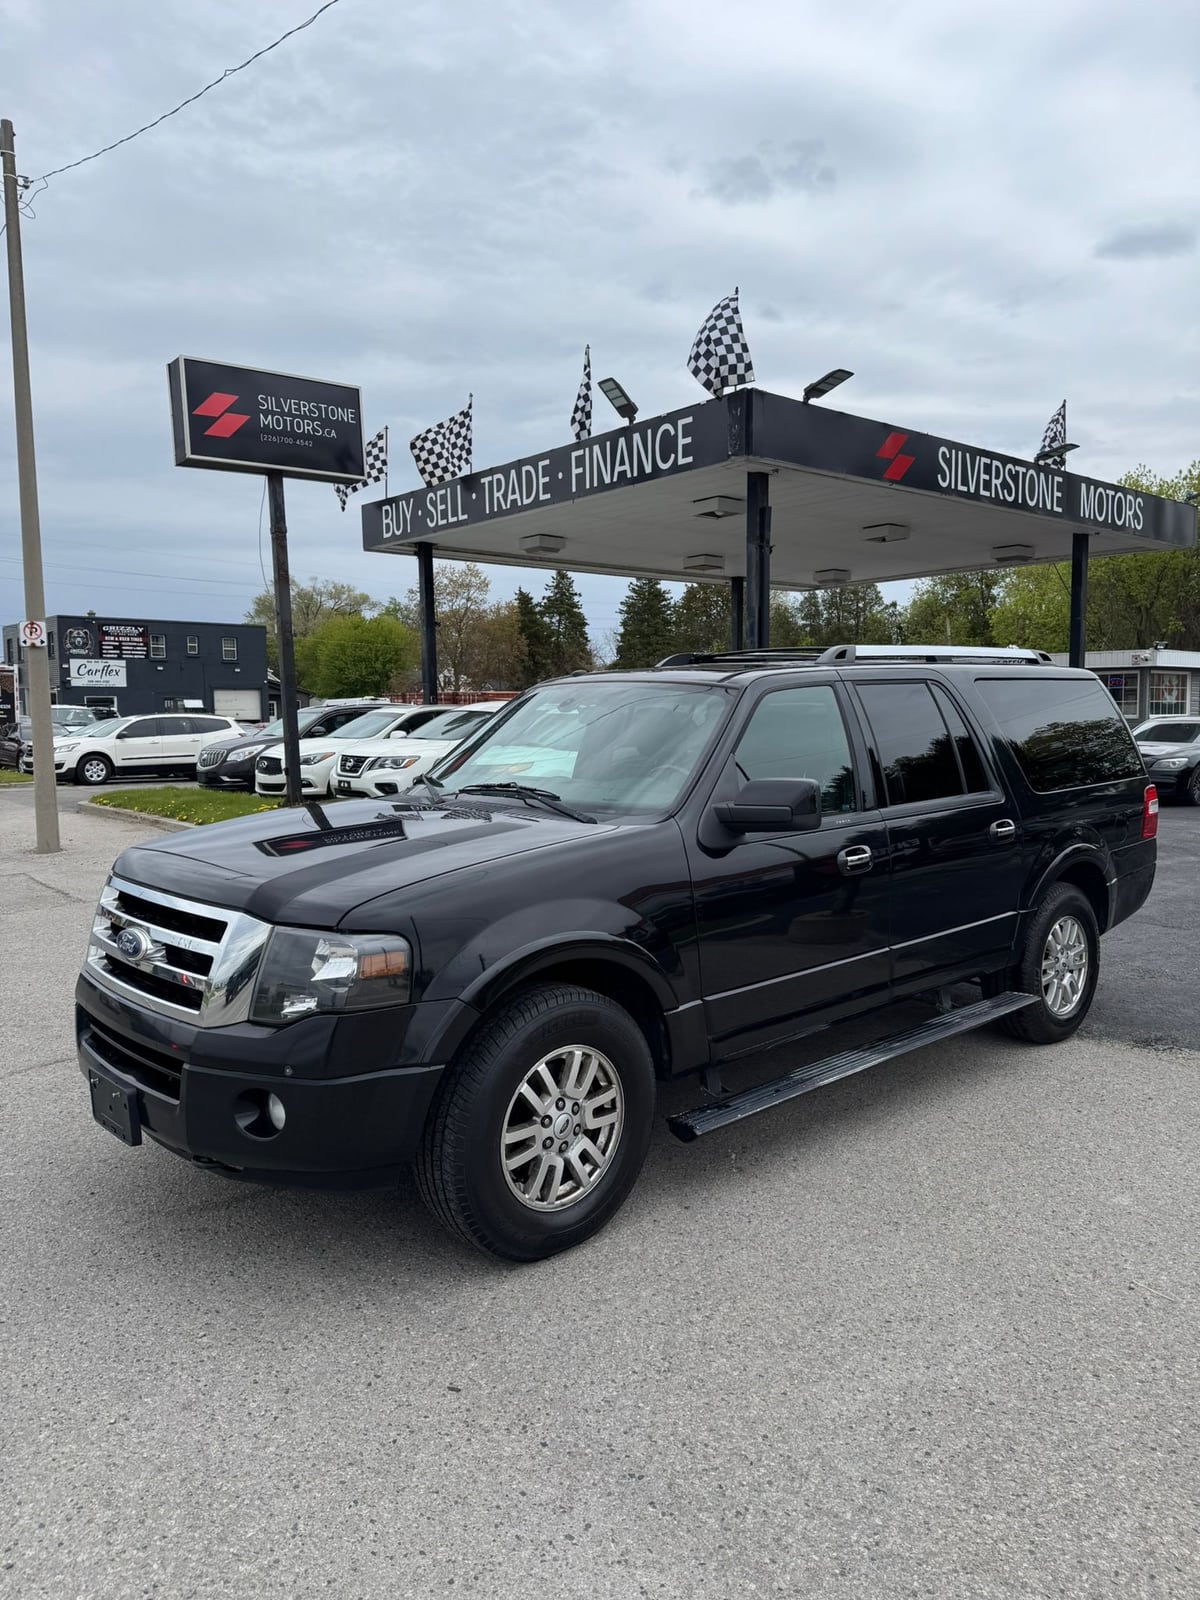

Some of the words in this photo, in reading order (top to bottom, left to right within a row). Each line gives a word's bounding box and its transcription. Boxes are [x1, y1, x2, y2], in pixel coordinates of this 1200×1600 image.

[257, 394, 356, 424] SILVERSTONE
[382, 498, 414, 538] BUY
[426, 485, 468, 527] SELL
[481, 459, 551, 514] TRADE
[571, 416, 694, 492] FINANCE
[937, 446, 1063, 513] SILVERSTONE
[1080, 483, 1144, 530] MOTORS
[77, 663, 121, 680] Carflex
[119, 932, 137, 953] Ford
